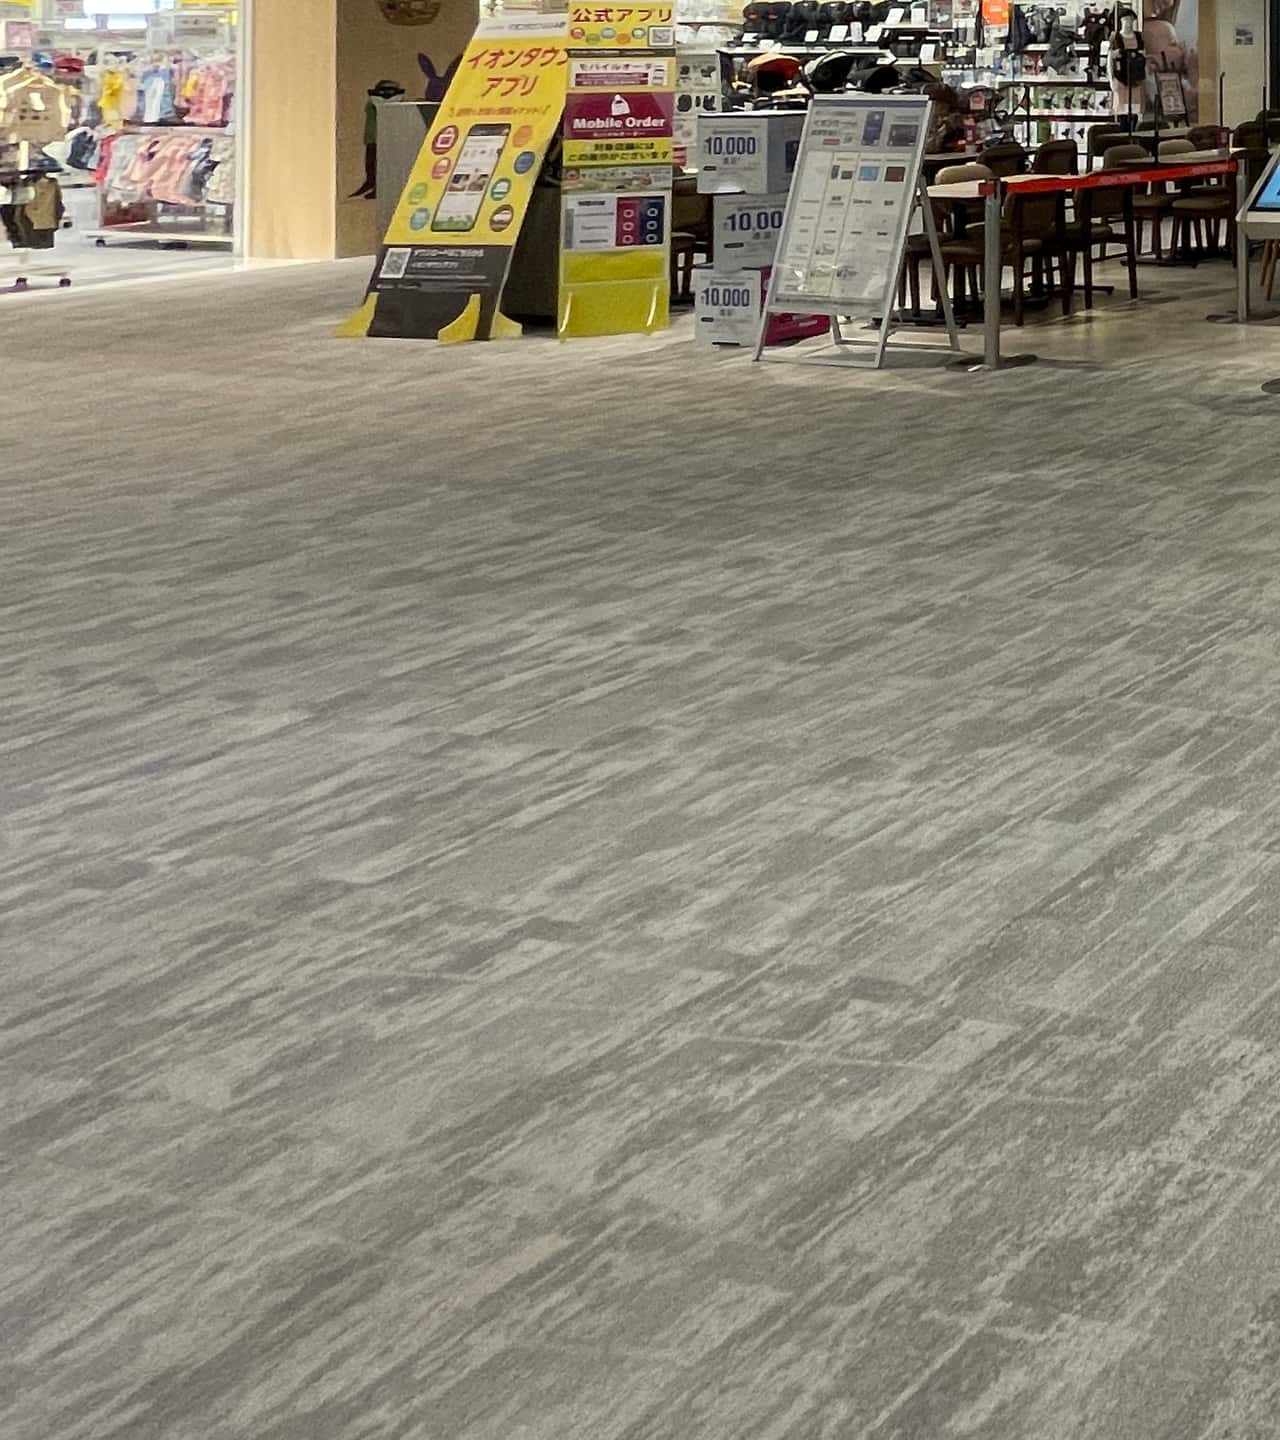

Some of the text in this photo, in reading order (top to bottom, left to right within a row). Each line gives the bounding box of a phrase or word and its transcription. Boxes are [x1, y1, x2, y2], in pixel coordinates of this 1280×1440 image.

[573, 8, 672, 23] 公式アプリ
[481, 75, 539, 97] アプリ
[573, 116, 666, 129] Mobile Order
[705, 136, 756, 156] 10,000
[726, 210, 783, 232] 10,00
[702, 288, 750, 307] 10,000
